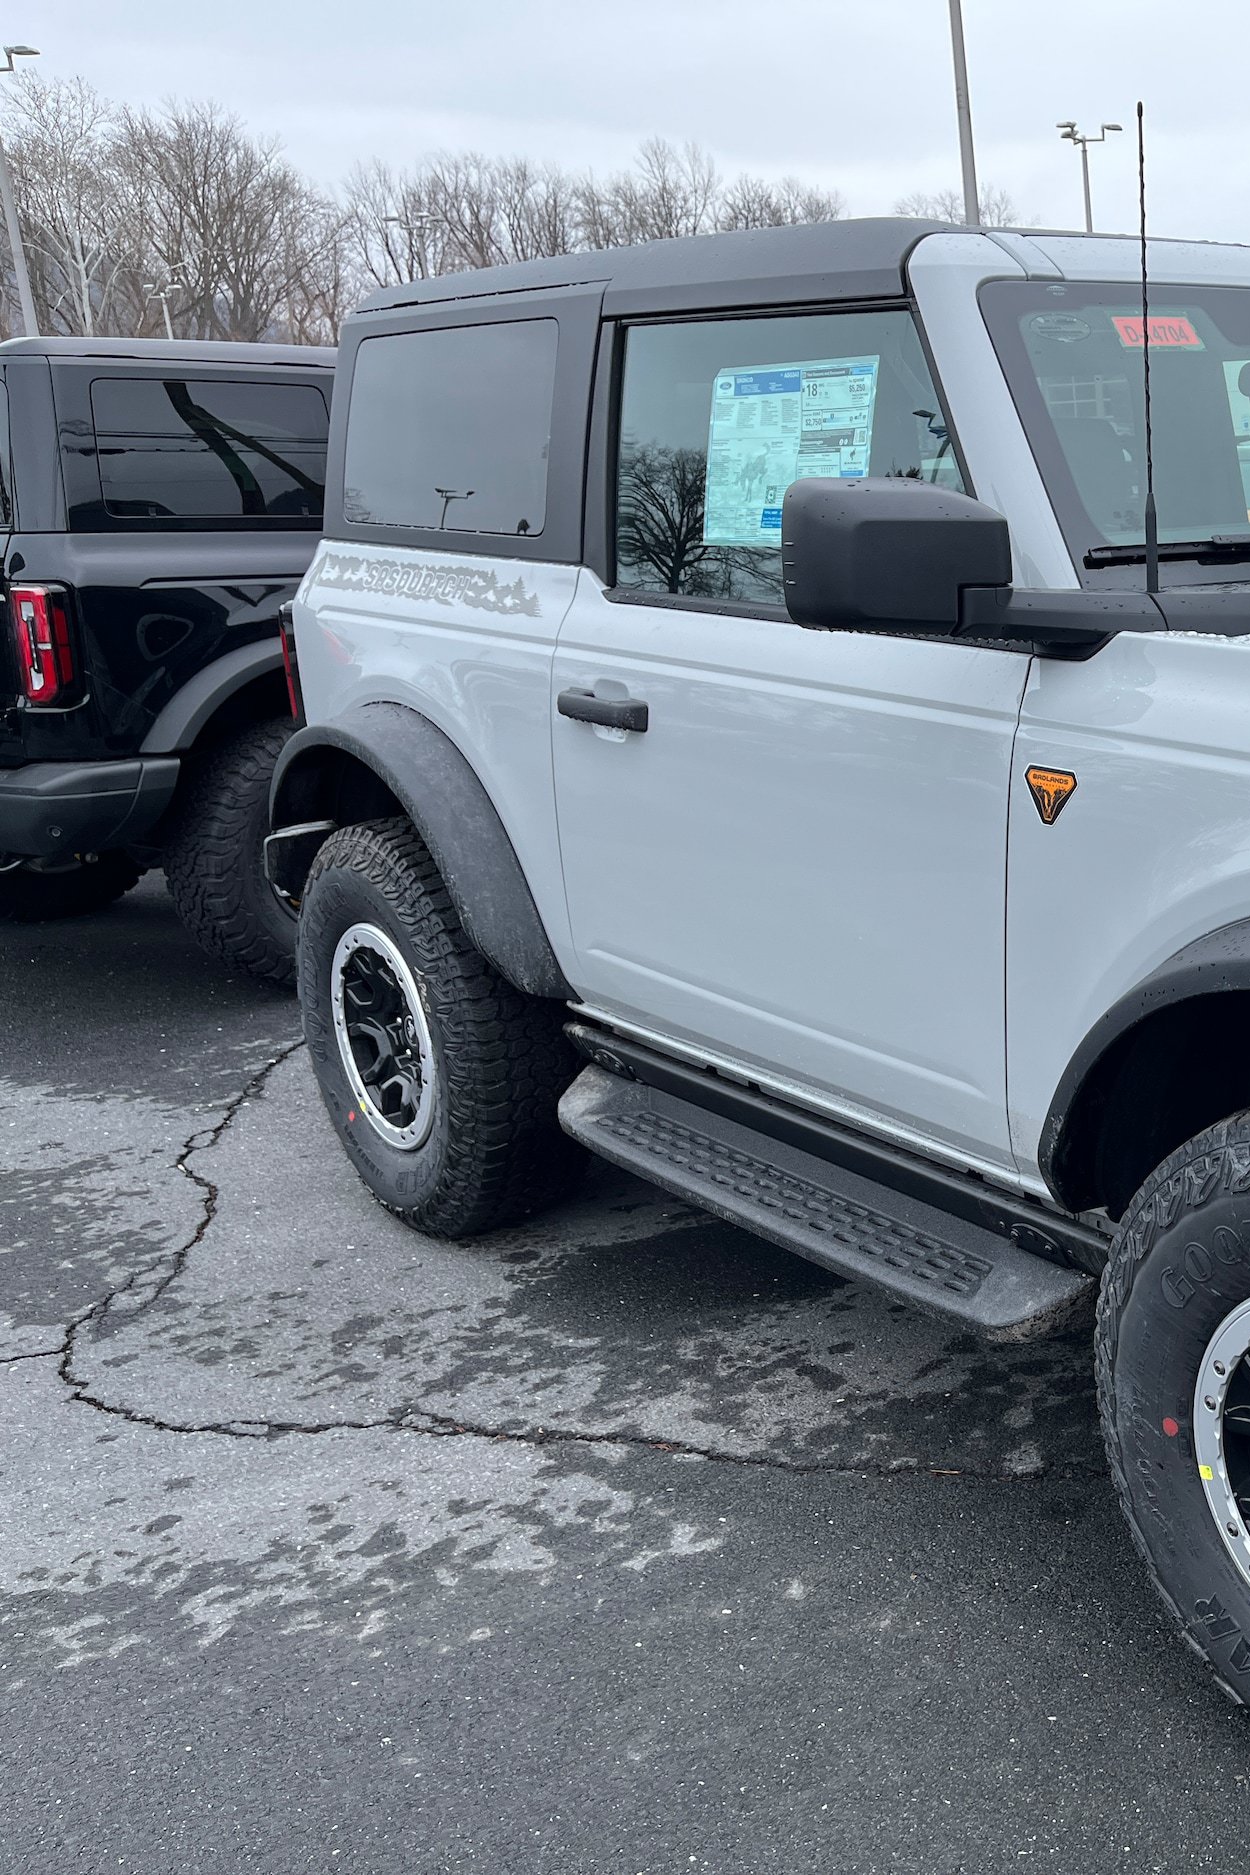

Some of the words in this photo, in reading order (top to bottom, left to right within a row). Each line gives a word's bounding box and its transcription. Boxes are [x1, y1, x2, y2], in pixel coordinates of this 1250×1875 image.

[806, 383, 818, 397] 18
[362, 563, 472, 601] SASQUATCH
[1032, 773, 1070, 786] BADLANDS
